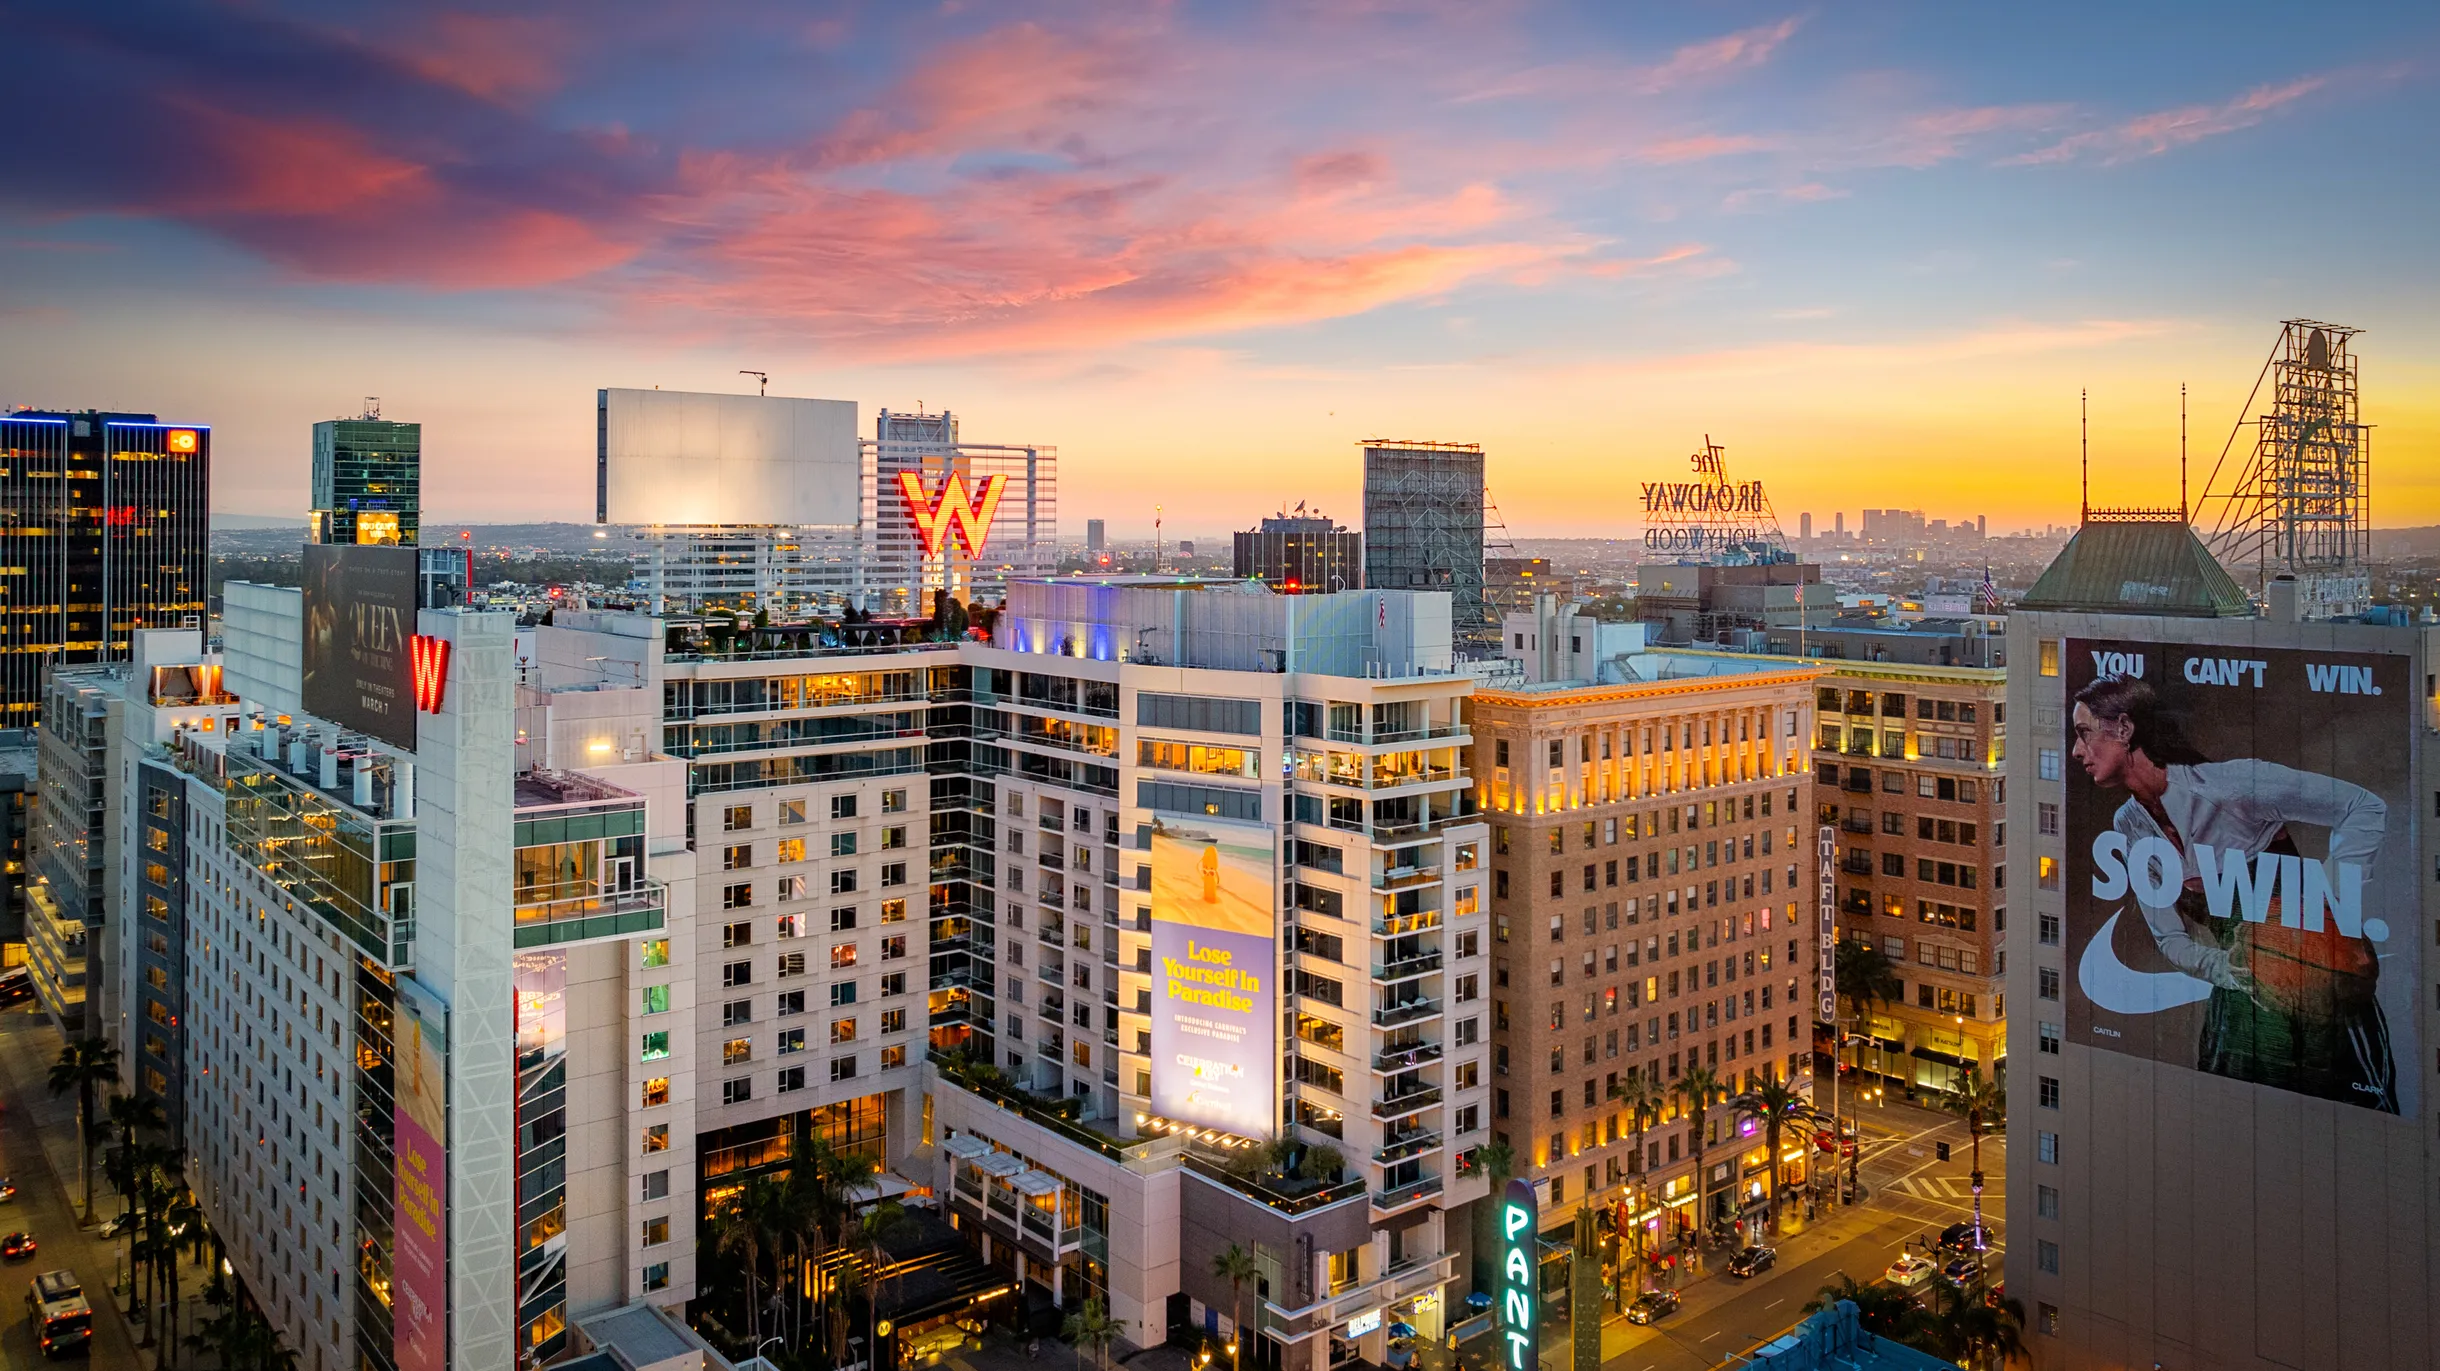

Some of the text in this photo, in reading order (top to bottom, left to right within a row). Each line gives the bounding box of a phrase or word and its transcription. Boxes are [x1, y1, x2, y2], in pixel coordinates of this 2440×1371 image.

[892, 471, 1009, 560] W
[349, 601, 404, 657] QUEEN
[411, 634, 451, 714] W
[2091, 651, 2382, 696] YOU CAN'T WIN.
[362, 695, 389, 715] MARCH 7
[2092, 831, 2389, 942] SO WIN.
[1821, 840, 1833, 1013] TAFT BLDG
[1162, 956, 1260, 993] Yourself In
[1188, 940, 1232, 966] Lose
[1168, 979, 1253, 1013] Paradise
[2093, 1026, 2121, 1037] CAITLIN
[2352, 1082, 2384, 1095] CLARK
[407, 1138, 426, 1176] Lose
[397, 1154, 429, 1206] Yourself
[399, 1183, 436, 1242] Paradise
